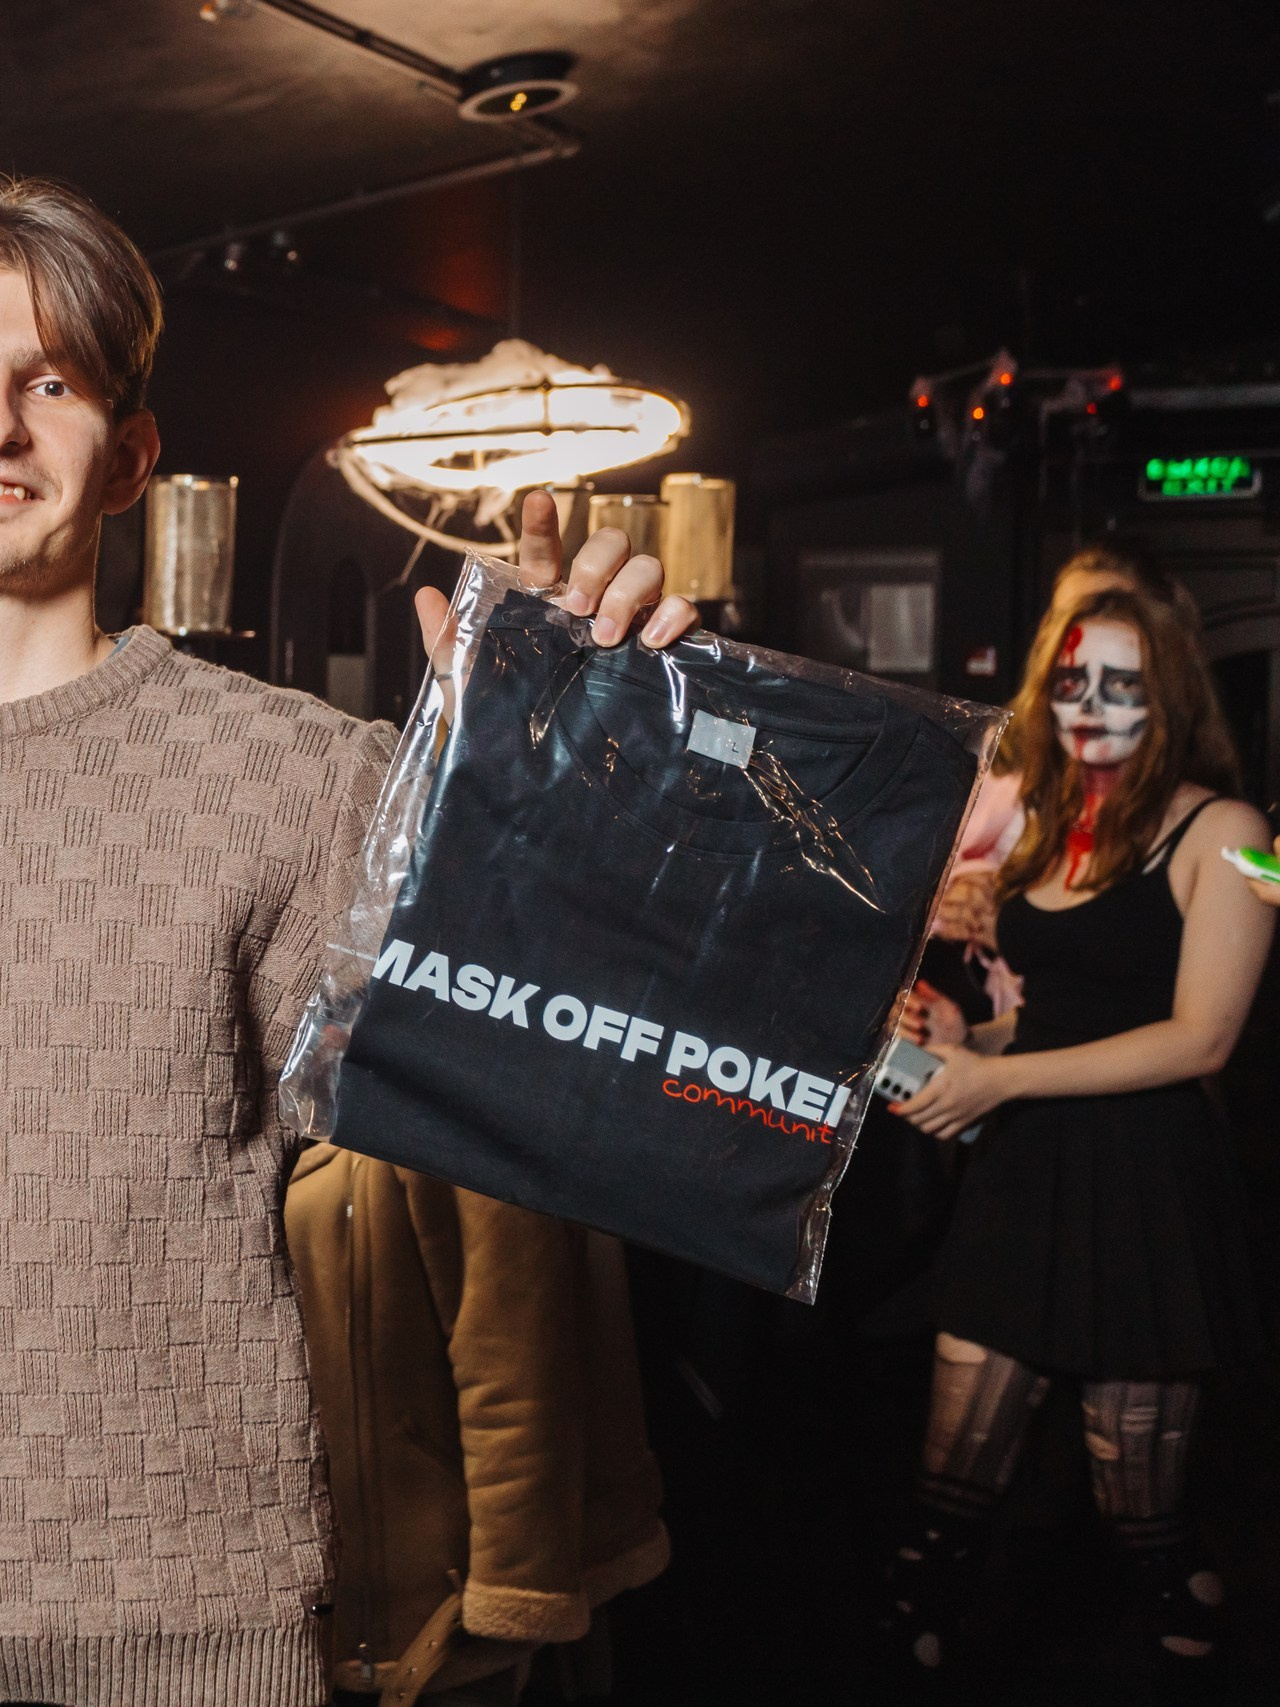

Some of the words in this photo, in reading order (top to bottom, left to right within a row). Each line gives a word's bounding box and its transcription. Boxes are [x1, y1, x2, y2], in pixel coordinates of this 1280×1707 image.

[732, 742, 739, 753] L
[372, 939, 541, 1029] MASK
[542, 994, 664, 1063] OFF
